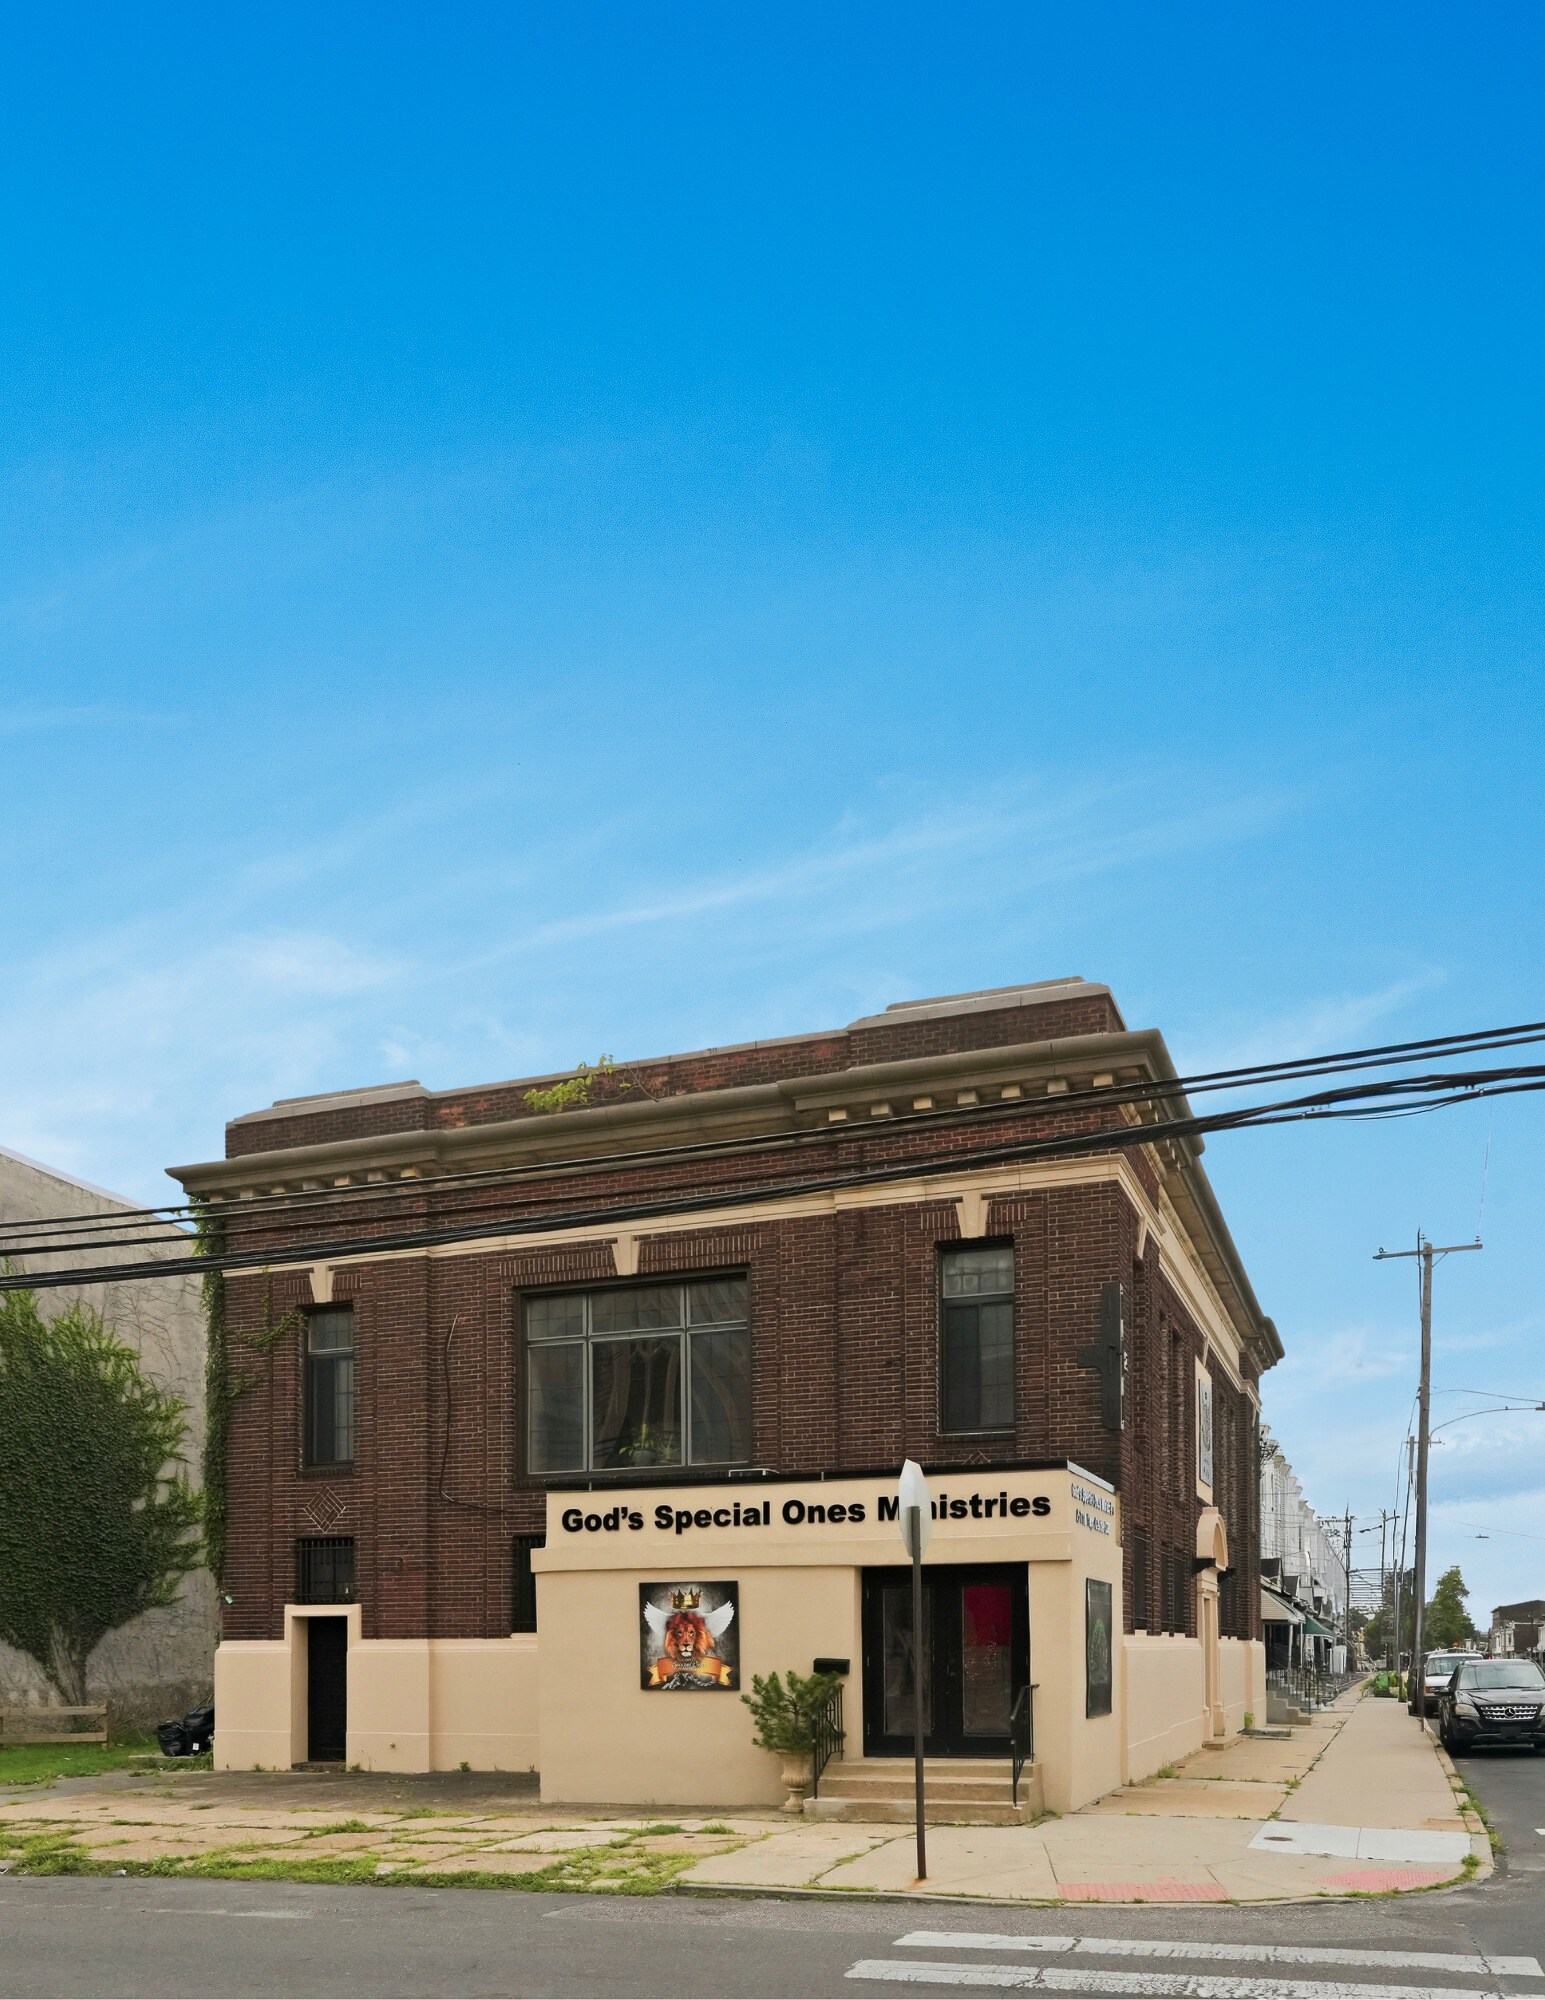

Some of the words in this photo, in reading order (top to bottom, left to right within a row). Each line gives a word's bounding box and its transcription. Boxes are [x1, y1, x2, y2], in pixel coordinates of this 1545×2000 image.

[561, 1507, 644, 1532] God's
[654, 1501, 771, 1535] Special
[781, 1500, 866, 1525] Ones
[877, 1491, 1051, 1522] Mistries
